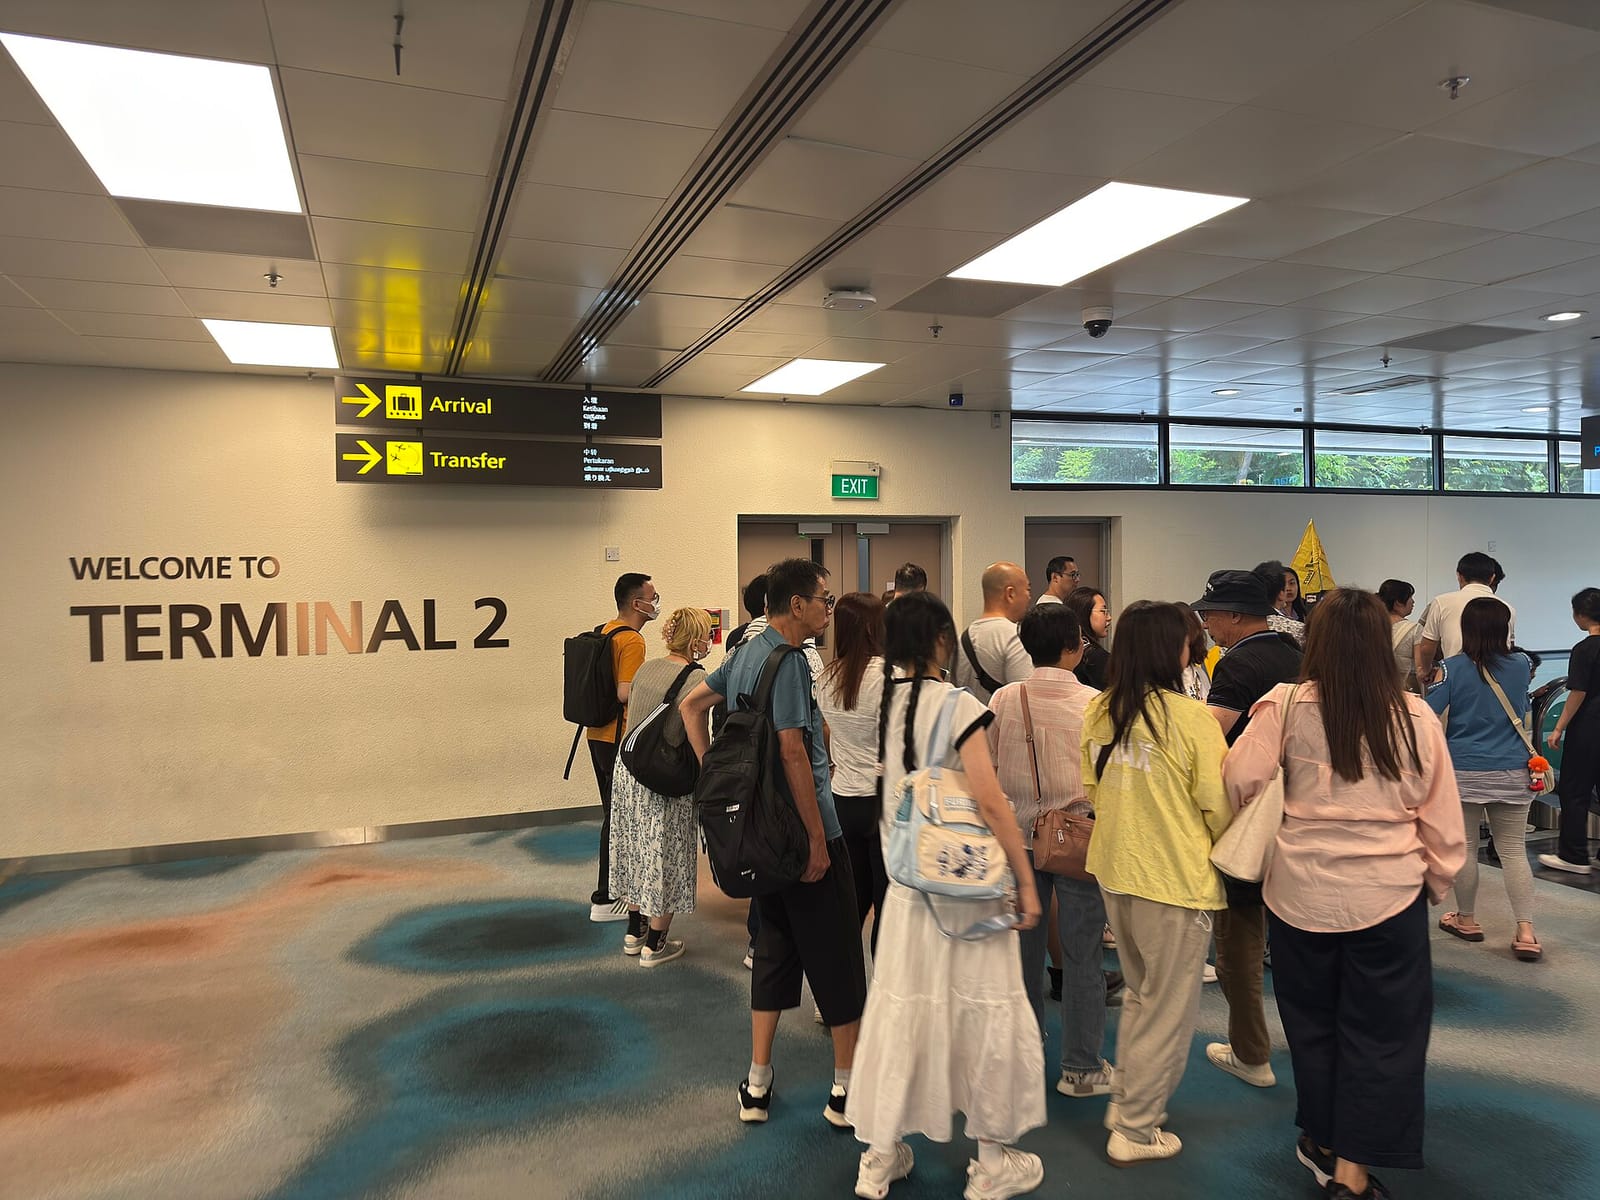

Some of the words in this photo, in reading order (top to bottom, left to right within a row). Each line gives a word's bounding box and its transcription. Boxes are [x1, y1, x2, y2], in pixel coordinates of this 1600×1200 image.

[430, 396, 492, 415] Arrival
[430, 451, 507, 470] Transfer
[841, 478, 868, 494] EXIT
[69, 556, 231, 581] WELCOME
[239, 556, 281, 579] TO
[70, 599, 457, 663] TERMINAL
[473, 596, 510, 649] 2
